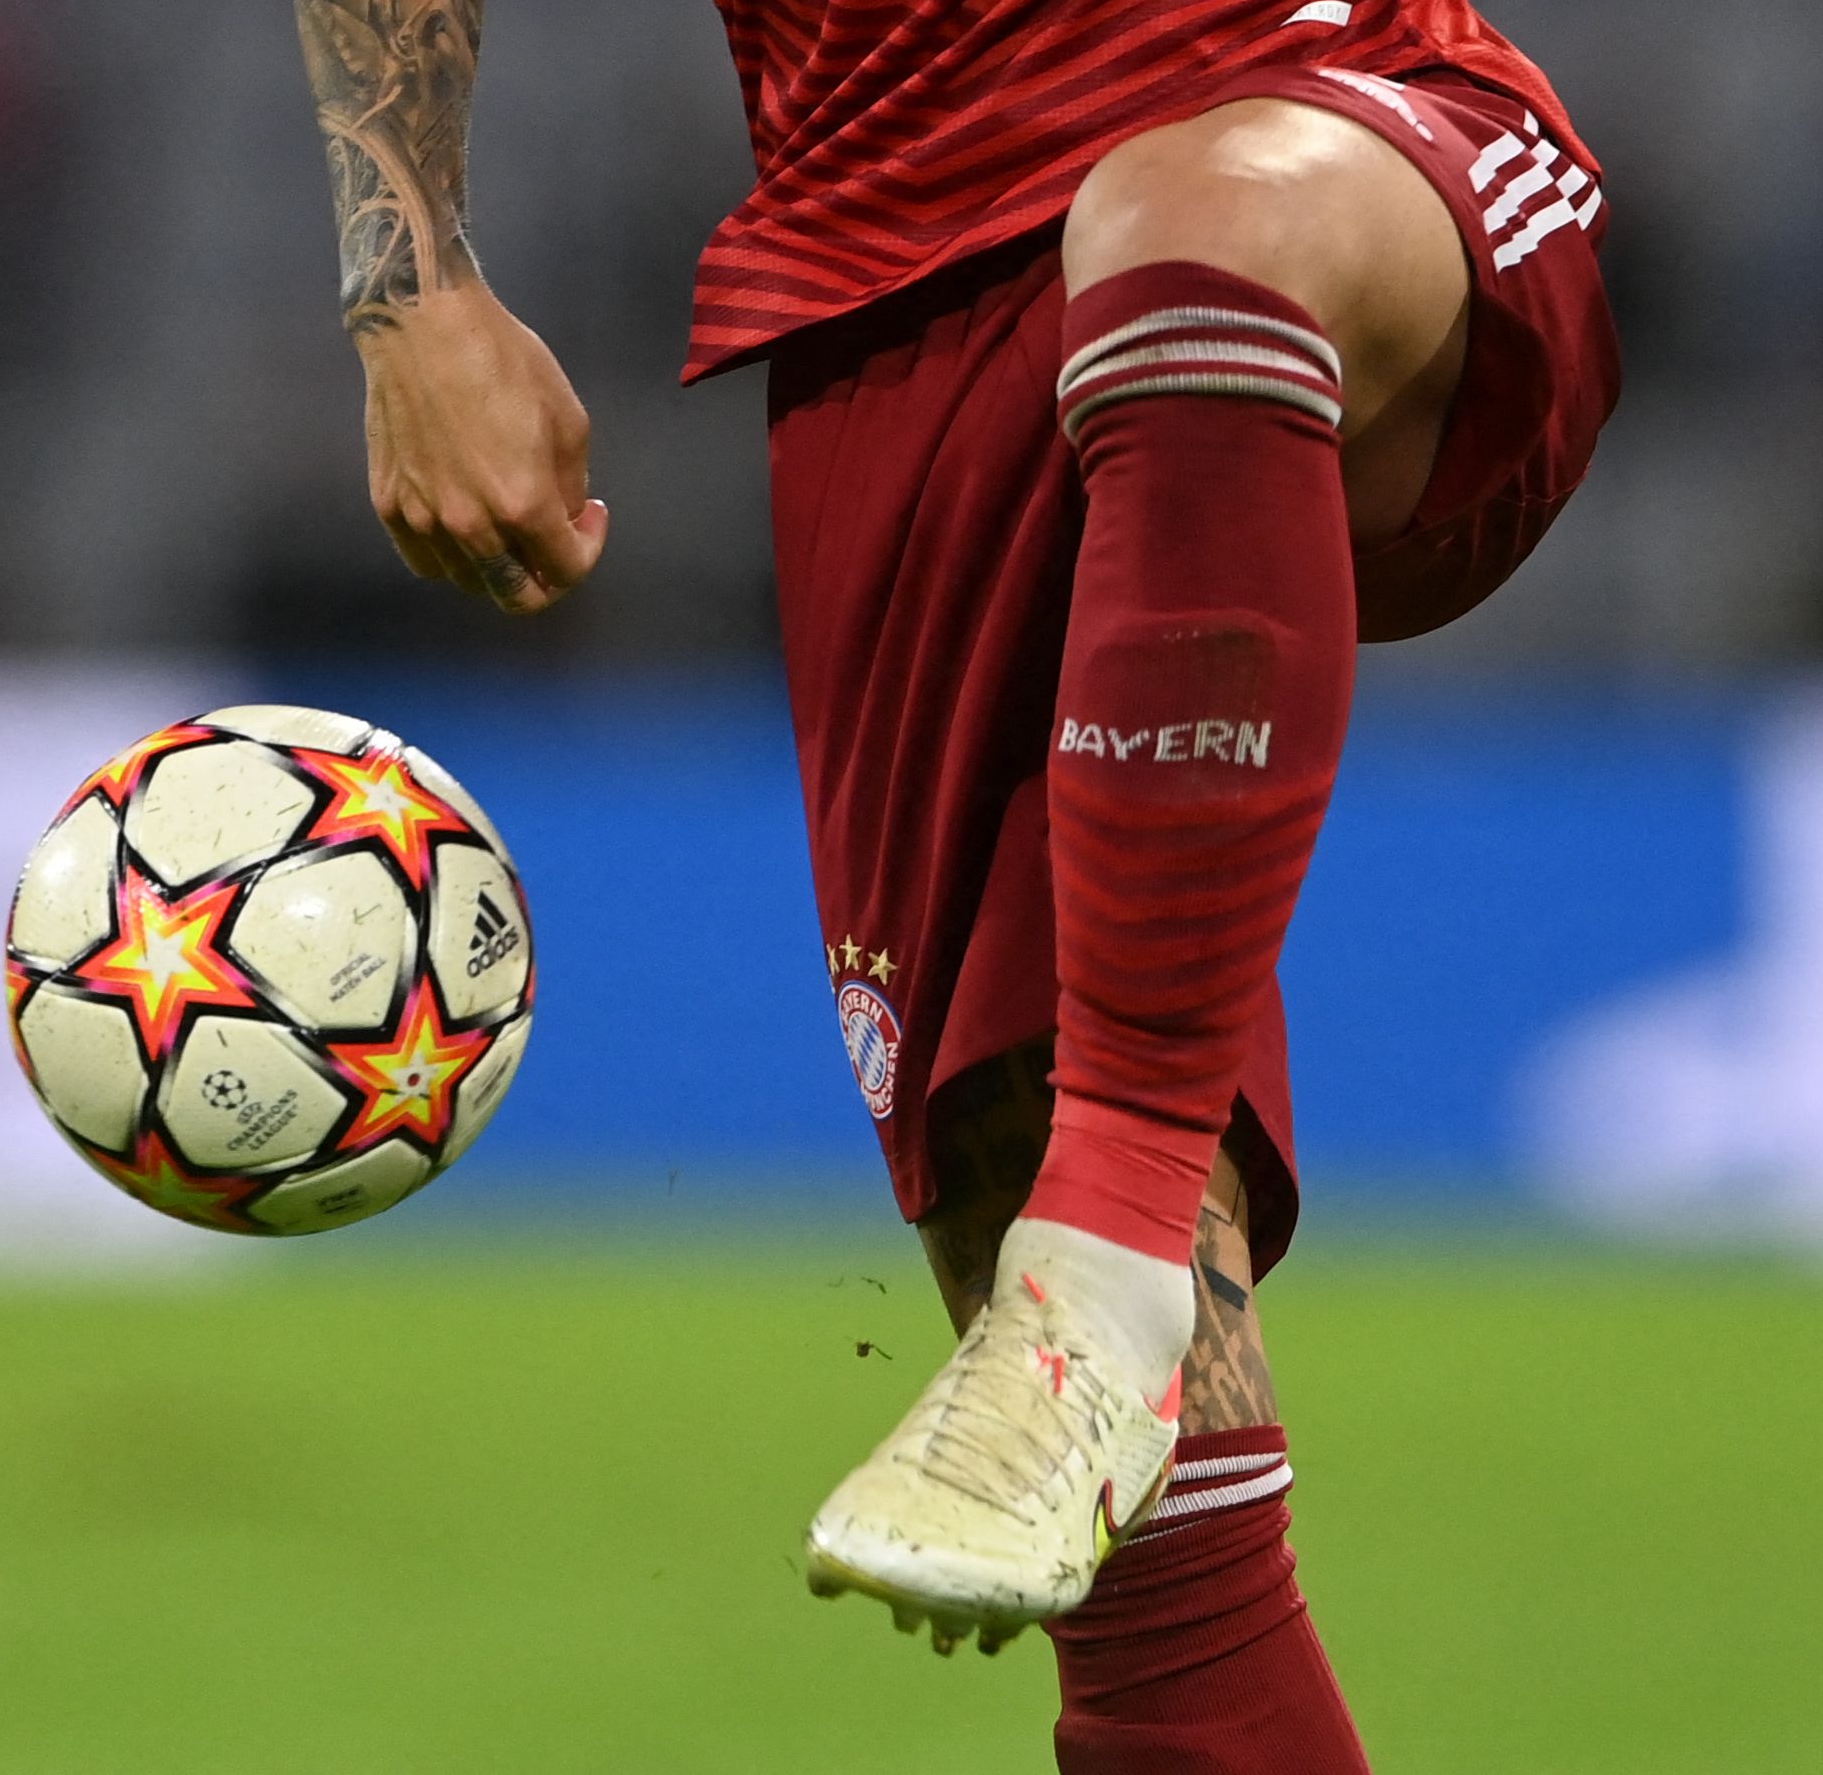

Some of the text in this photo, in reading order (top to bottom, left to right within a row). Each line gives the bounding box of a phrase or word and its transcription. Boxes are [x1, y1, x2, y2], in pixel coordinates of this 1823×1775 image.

[1058, 716, 1272, 768] BAYERN
[466, 926, 519, 978] adidas
[227, 1089, 298, 1151] CHAMPIONS
